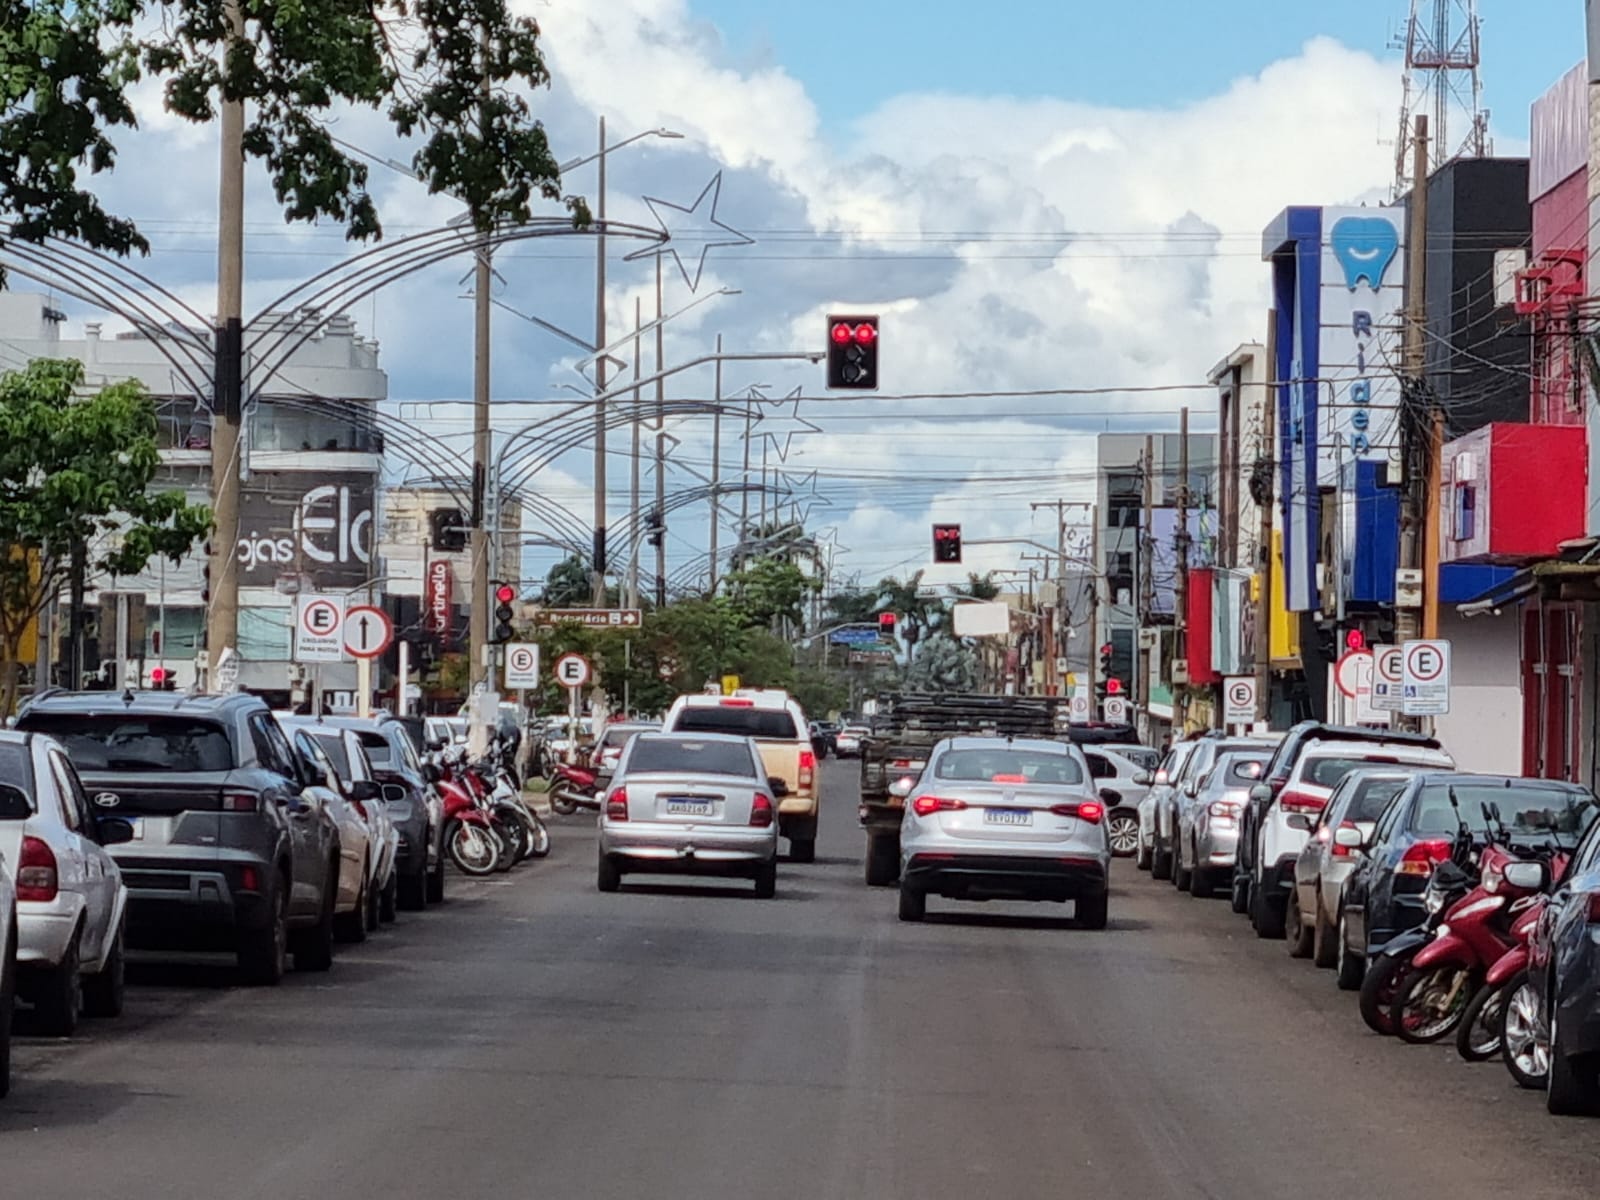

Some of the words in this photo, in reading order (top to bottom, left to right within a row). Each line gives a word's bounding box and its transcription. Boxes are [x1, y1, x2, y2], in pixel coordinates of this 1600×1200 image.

[1350, 310, 1372, 456] Riden
[238, 531, 294, 571] ojas
[432, 563, 446, 643] artinello
[313, 608, 329, 628] E
[517, 653, 528, 667] E
[1389, 655, 1403, 675] E
[1419, 651, 1433, 674] E
[564, 661, 580, 680] E
[1235, 687, 1247, 701] E
